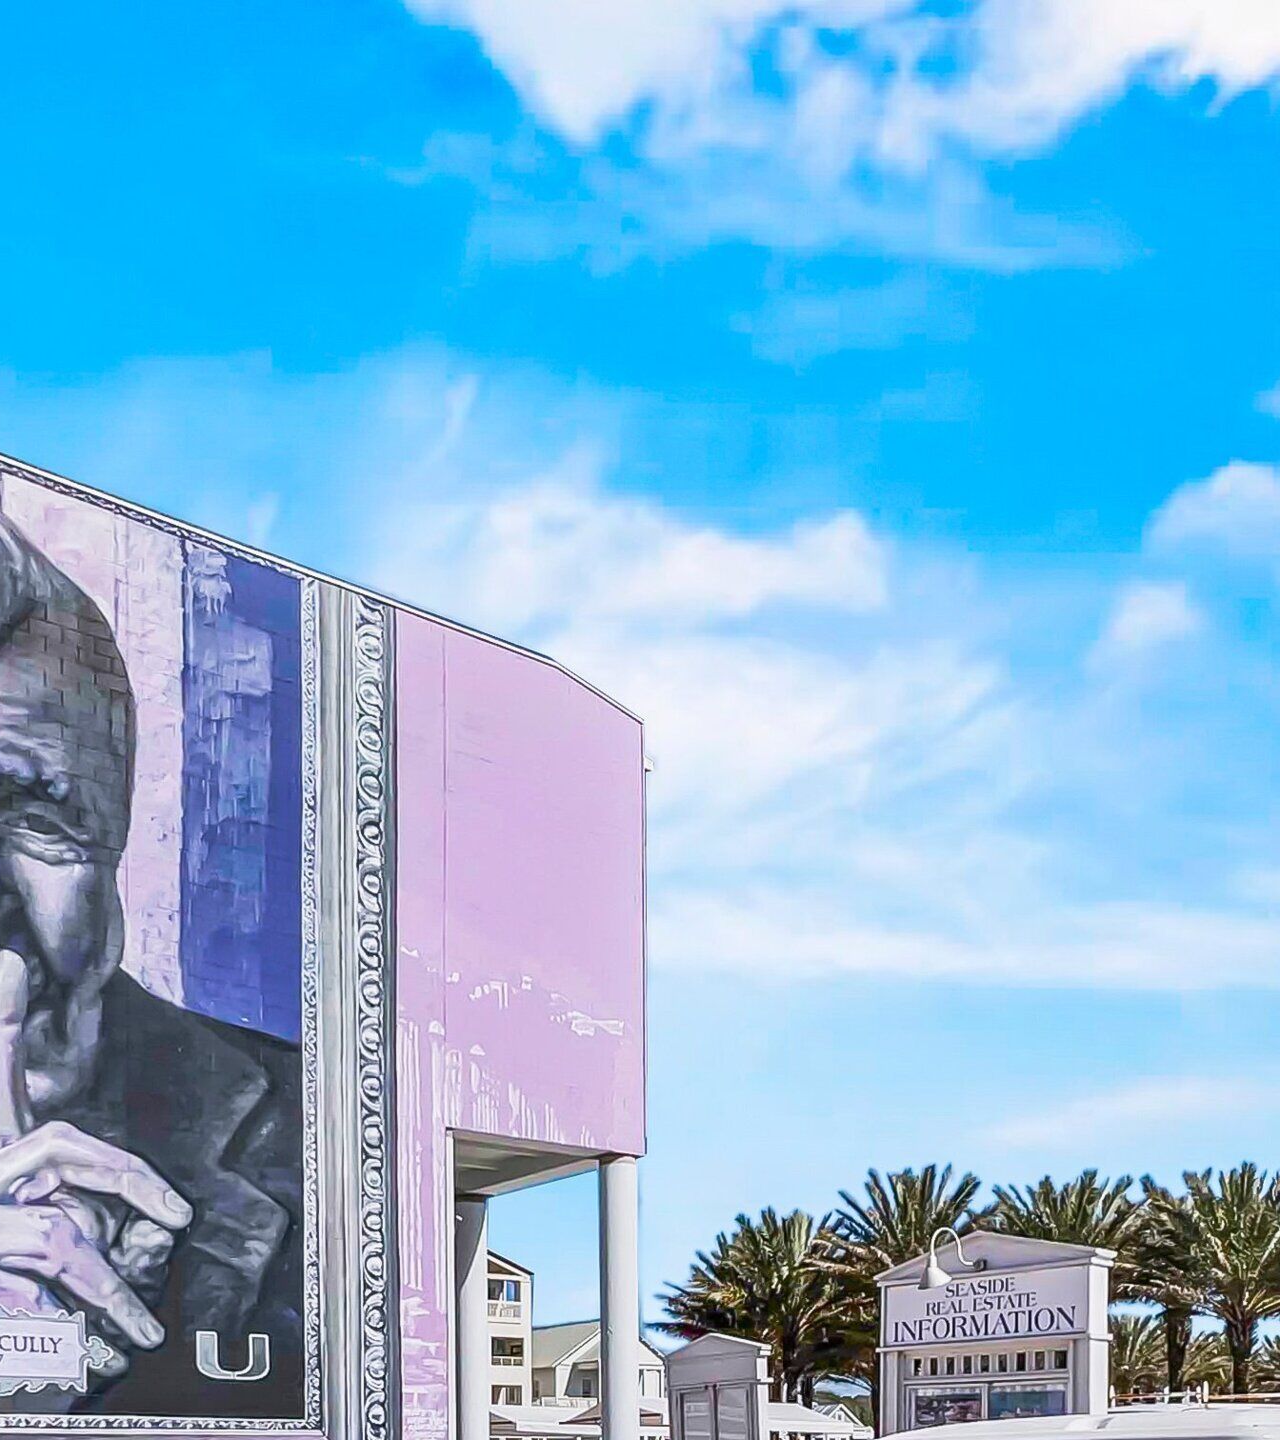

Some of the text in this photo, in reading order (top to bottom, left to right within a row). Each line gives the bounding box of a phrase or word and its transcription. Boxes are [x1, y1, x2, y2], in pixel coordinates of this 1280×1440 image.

[925, 1291, 1038, 1317] REAL ESTATE
[944, 1277, 1016, 1299] SEASIDE
[893, 1305, 1076, 1343] INFORMATION
[195, 1330, 270, 1381] U
